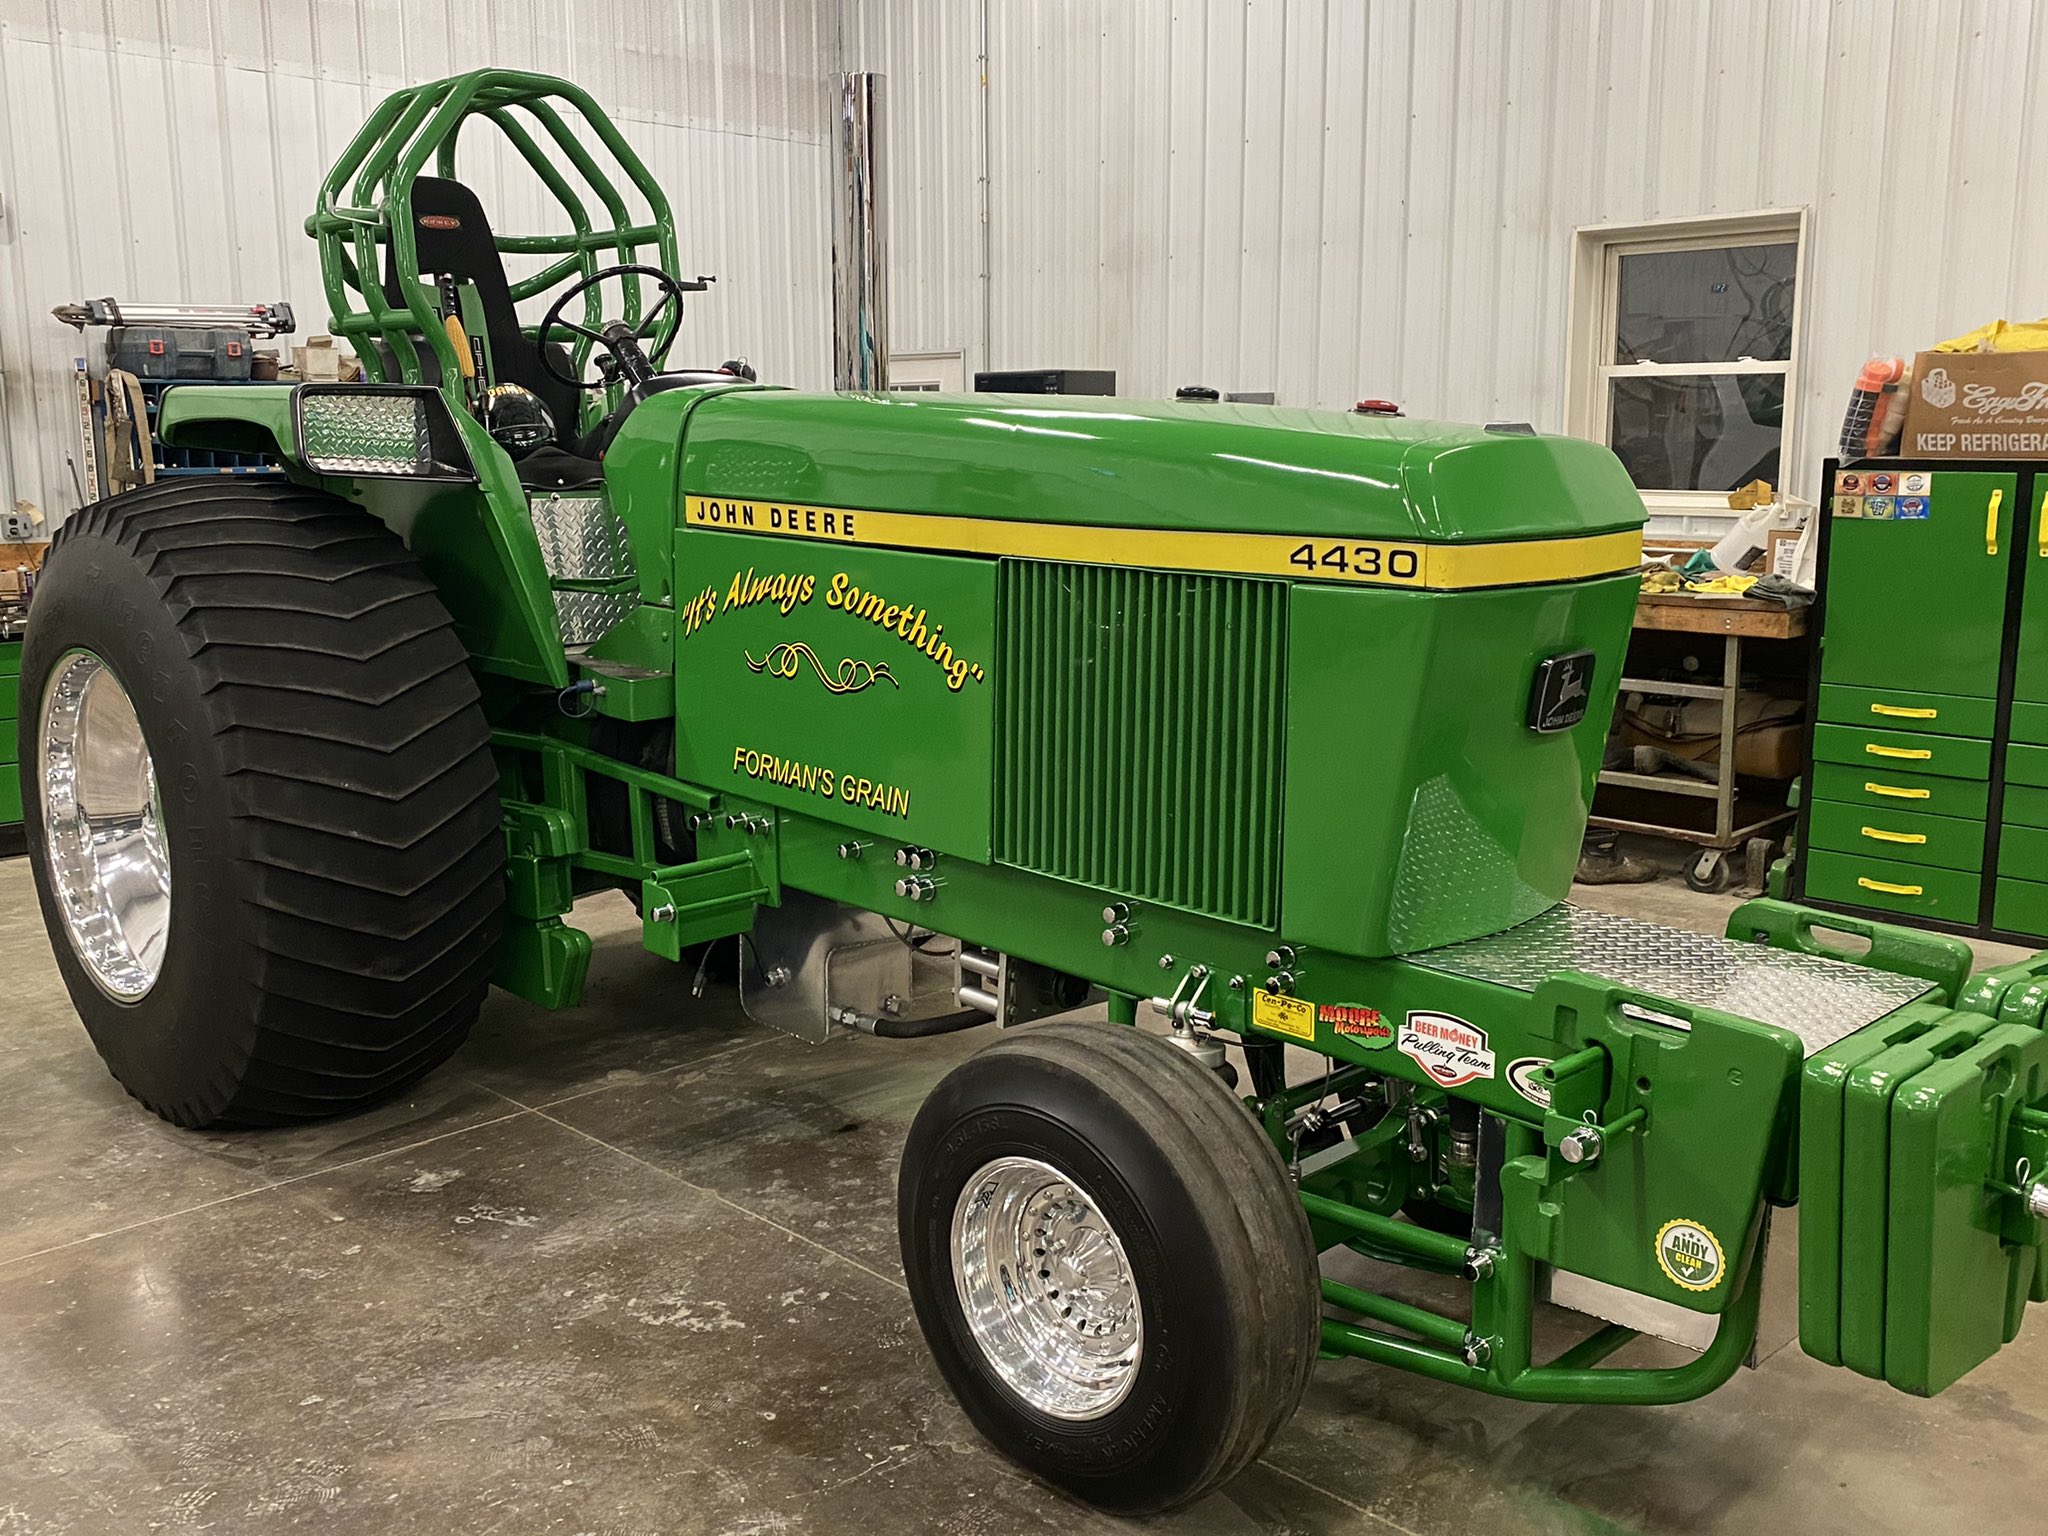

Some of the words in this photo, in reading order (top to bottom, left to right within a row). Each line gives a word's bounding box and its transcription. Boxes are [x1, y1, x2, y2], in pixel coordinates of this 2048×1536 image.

[473, 337, 488, 396] CIPHE
[1917, 433, 1956, 451] KEEP
[697, 501, 753, 526] JOHN
[770, 508, 855, 536] DEERE
[1290, 543, 1418, 578] 4430
[722, 566, 817, 615] Always
[825, 572, 985, 690] Something"
[733, 746, 835, 797] FORMAN'S
[840, 774, 911, 817] GRAIN
[1319, 1004, 1380, 1027] MOORE
[1333, 1020, 1390, 1039] Motorsports
[1415, 1020, 1439, 1038] BEER
[1439, 1028, 1479, 1049] MONEY
[1400, 1033, 1456, 1064] Pulling
[1455, 1046, 1491, 1071] Team
[1672, 1235, 1709, 1260] ANDY
[1675, 1252, 1703, 1270] CLEAN
